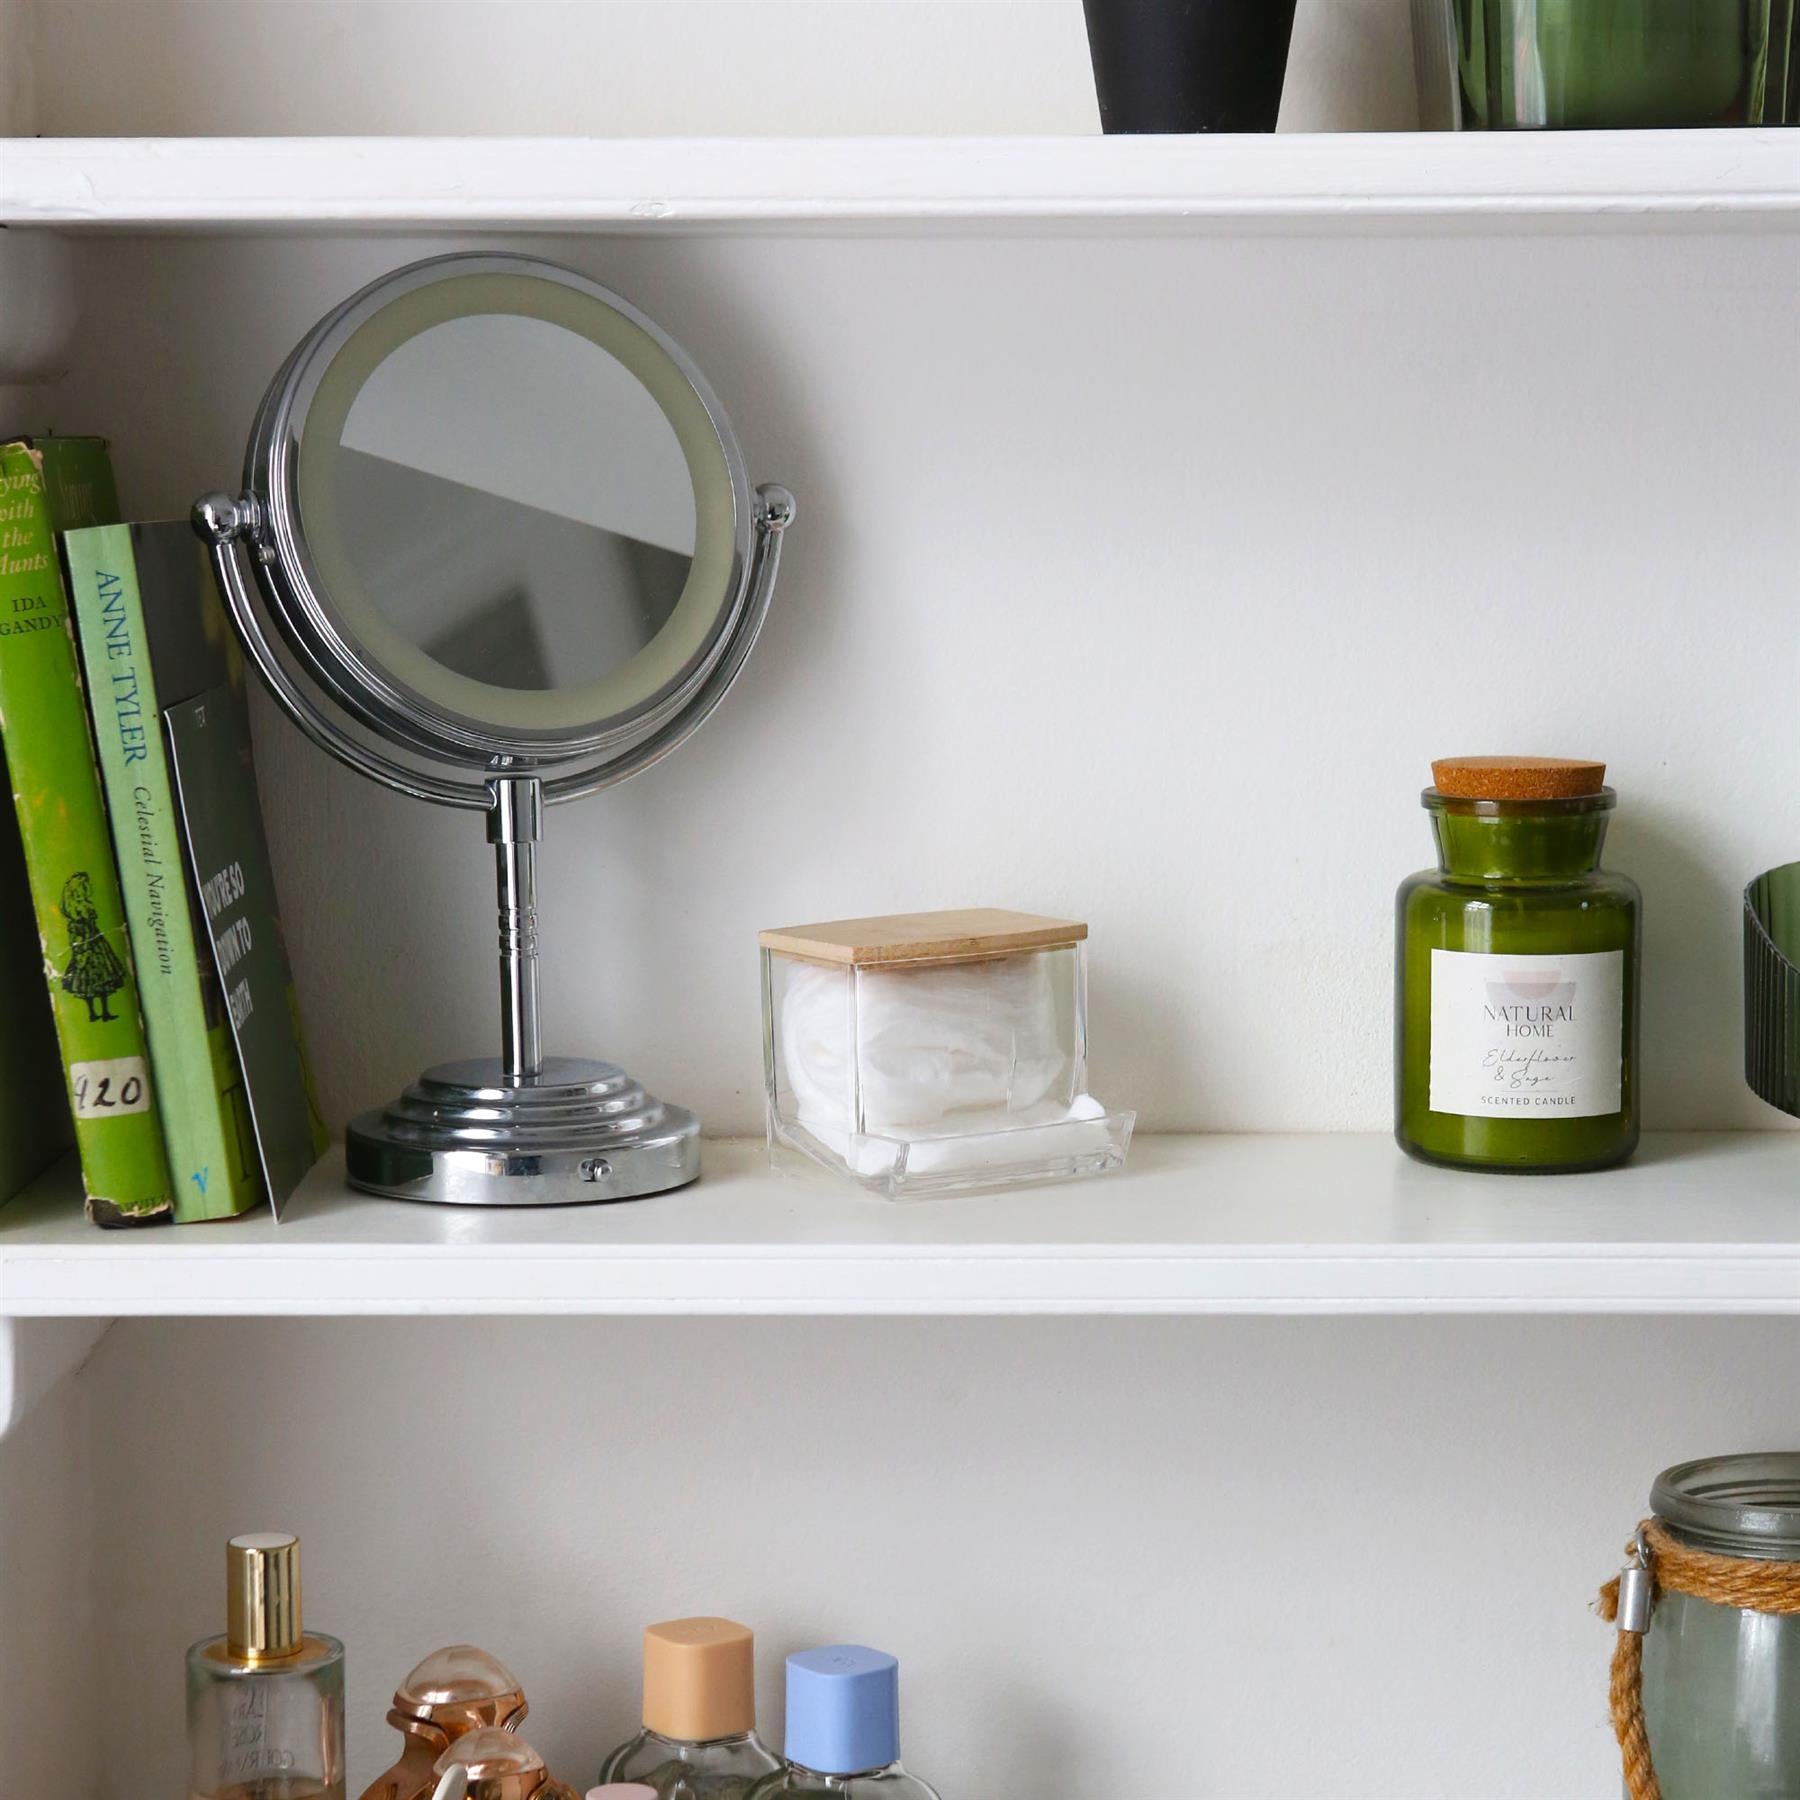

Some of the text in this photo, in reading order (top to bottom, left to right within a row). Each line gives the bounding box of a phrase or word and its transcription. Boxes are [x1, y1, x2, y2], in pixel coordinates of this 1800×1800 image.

[3, 527, 34, 549] the
[12, 595, 49, 612] IDA
[0, 615, 64, 636] GANDY
[96, 570, 148, 767] ANNE TYLER
[134, 786, 174, 975] Celestial Navigation
[229, 861, 245, 900] SO
[235, 916, 252, 955] TO
[1484, 1005, 1576, 1022] NATURAL
[1507, 1024, 1554, 1038] HOME
[1482, 1049, 1576, 1071] Elderflower
[1494, 1065, 1553, 1089] & Sage
[1481, 1096, 1576, 1106] SCENTED CANDLE
